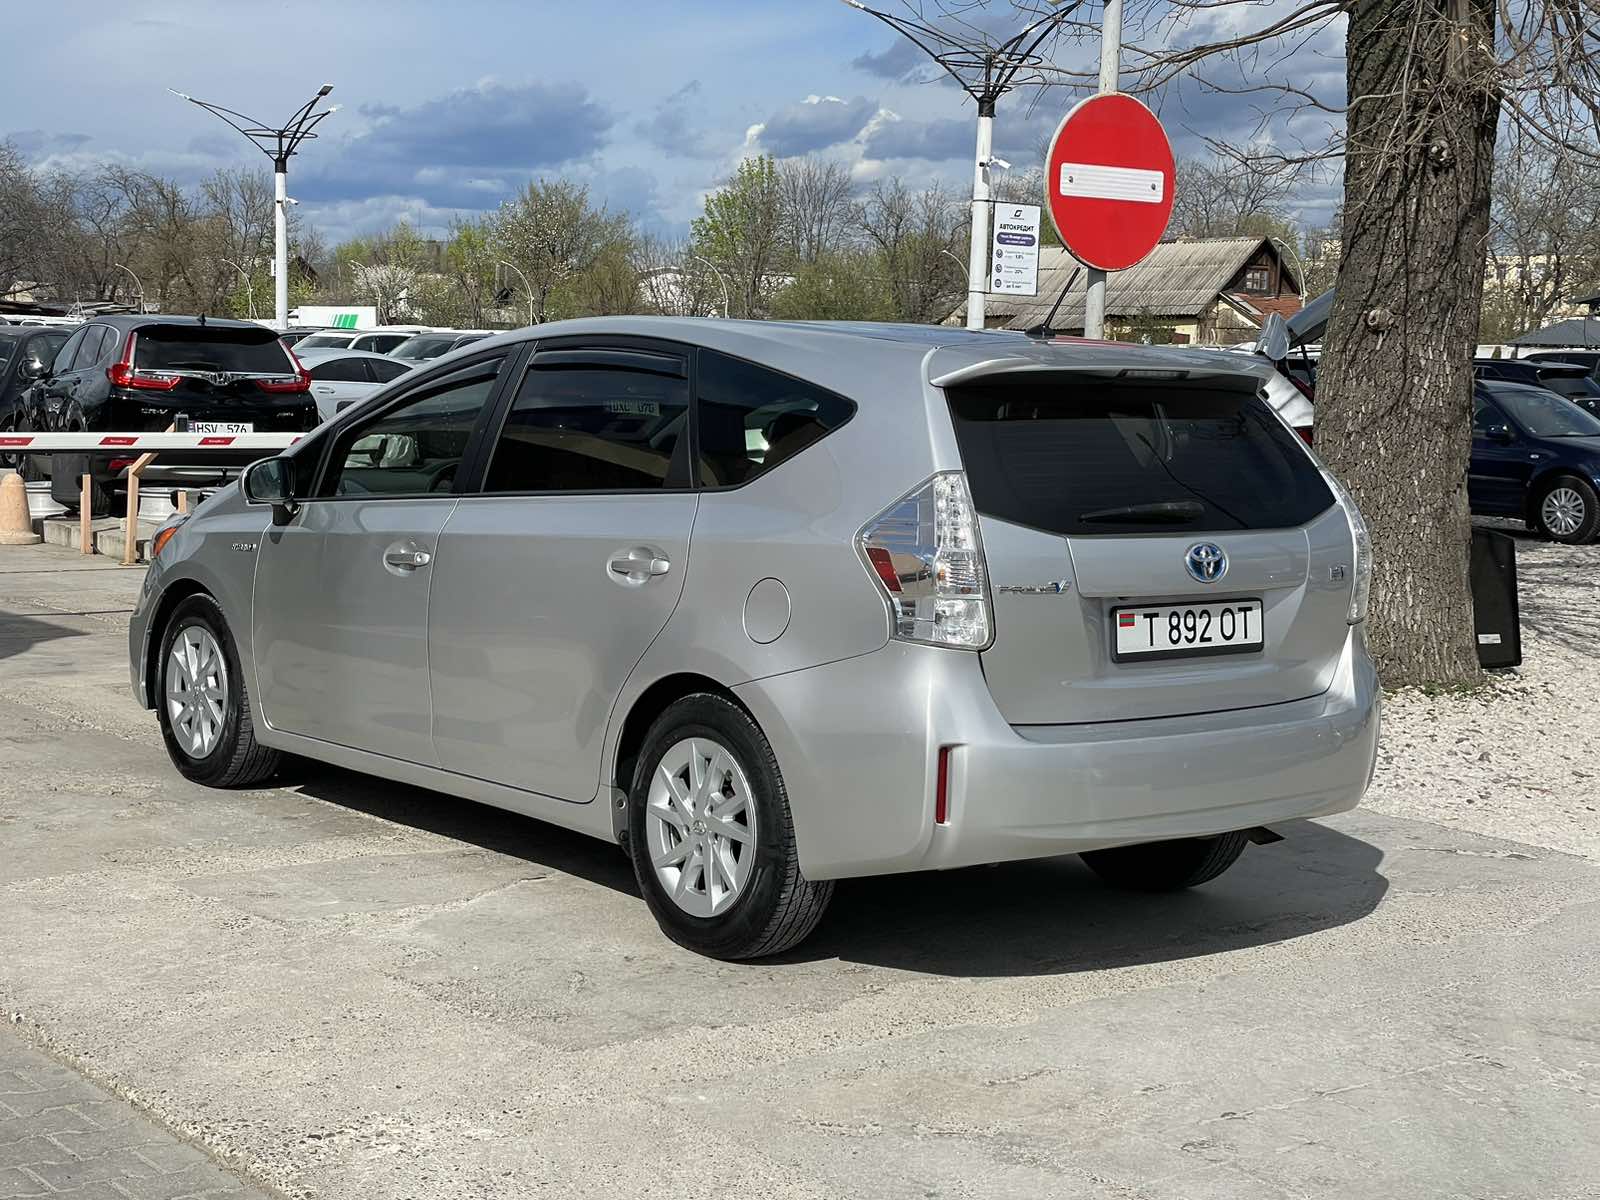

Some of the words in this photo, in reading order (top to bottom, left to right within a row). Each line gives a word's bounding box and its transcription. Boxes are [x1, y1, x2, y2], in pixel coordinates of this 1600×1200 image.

[999, 223, 1034, 231] АВТОКРЕДИТ
[196, 423, 218, 433] HSV
[226, 424, 247, 433] 576
[1143, 612, 1159, 647] T
[1168, 609, 1213, 645] 892
[1220, 606, 1253, 641] OT
